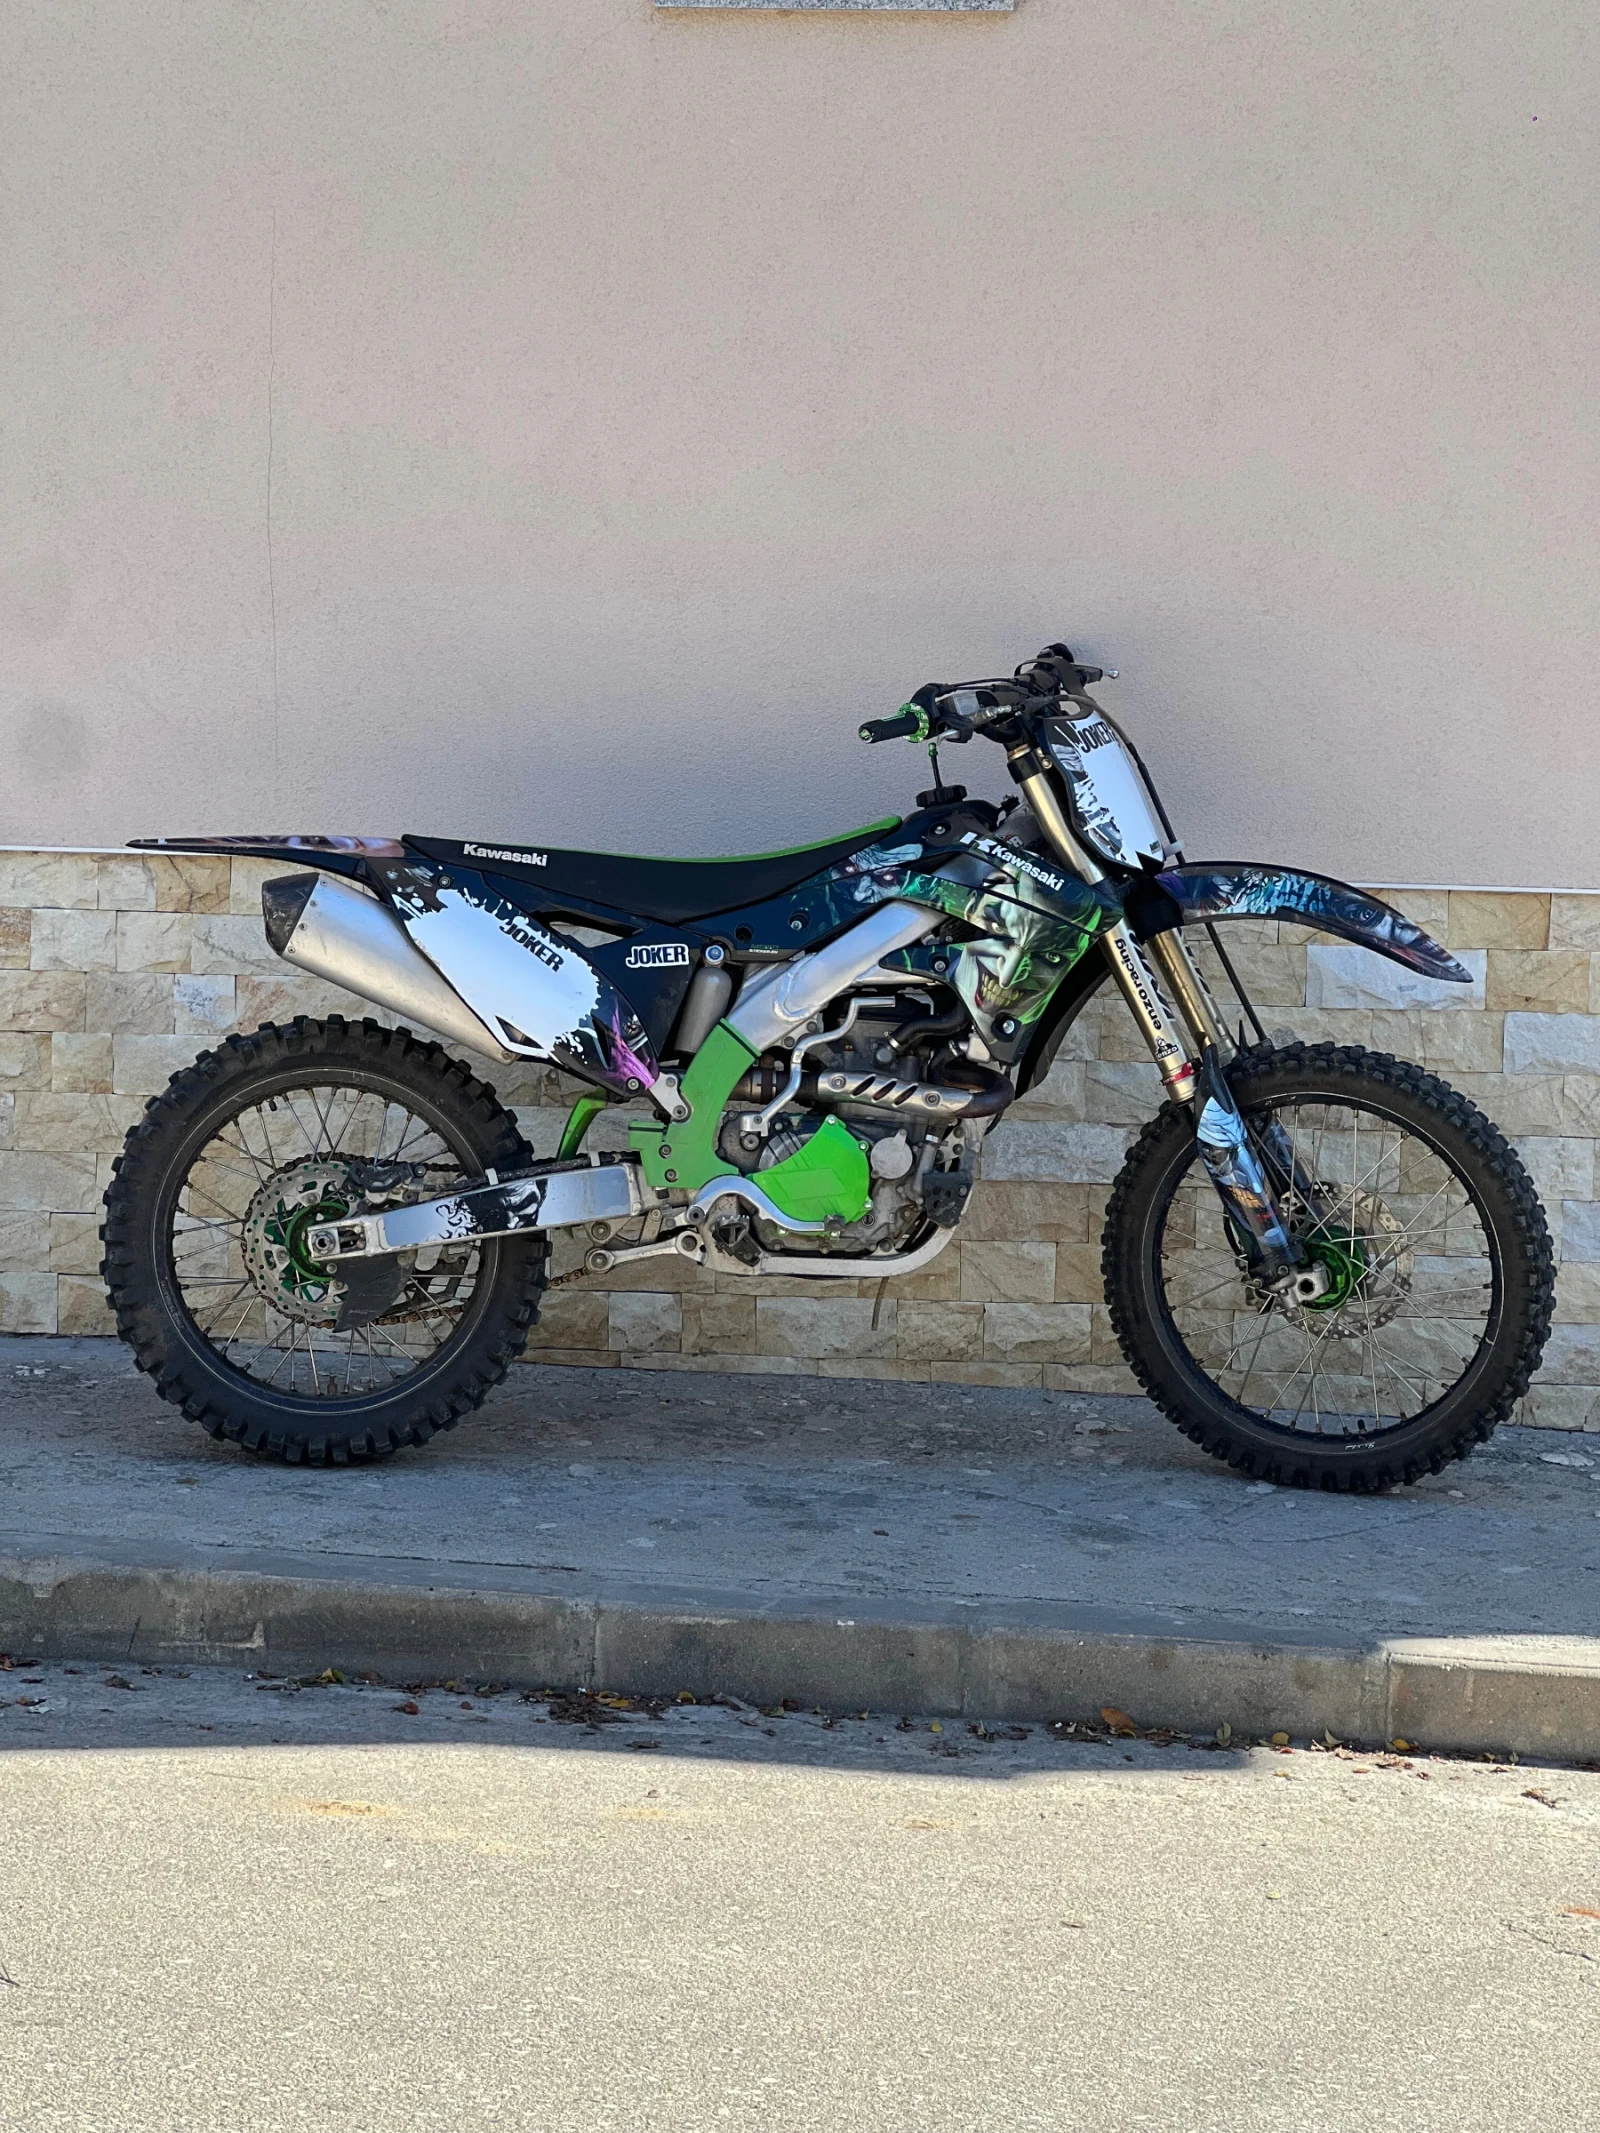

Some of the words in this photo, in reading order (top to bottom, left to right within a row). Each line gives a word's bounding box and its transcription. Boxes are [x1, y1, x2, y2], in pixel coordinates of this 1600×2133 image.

[1077, 721, 1117, 754] JOKER
[462, 843, 548, 867] Kawasaki
[991, 844, 1065, 892] Kawasaki
[499, 923, 565, 972] JOKER
[626, 944, 688, 967] JOKER
